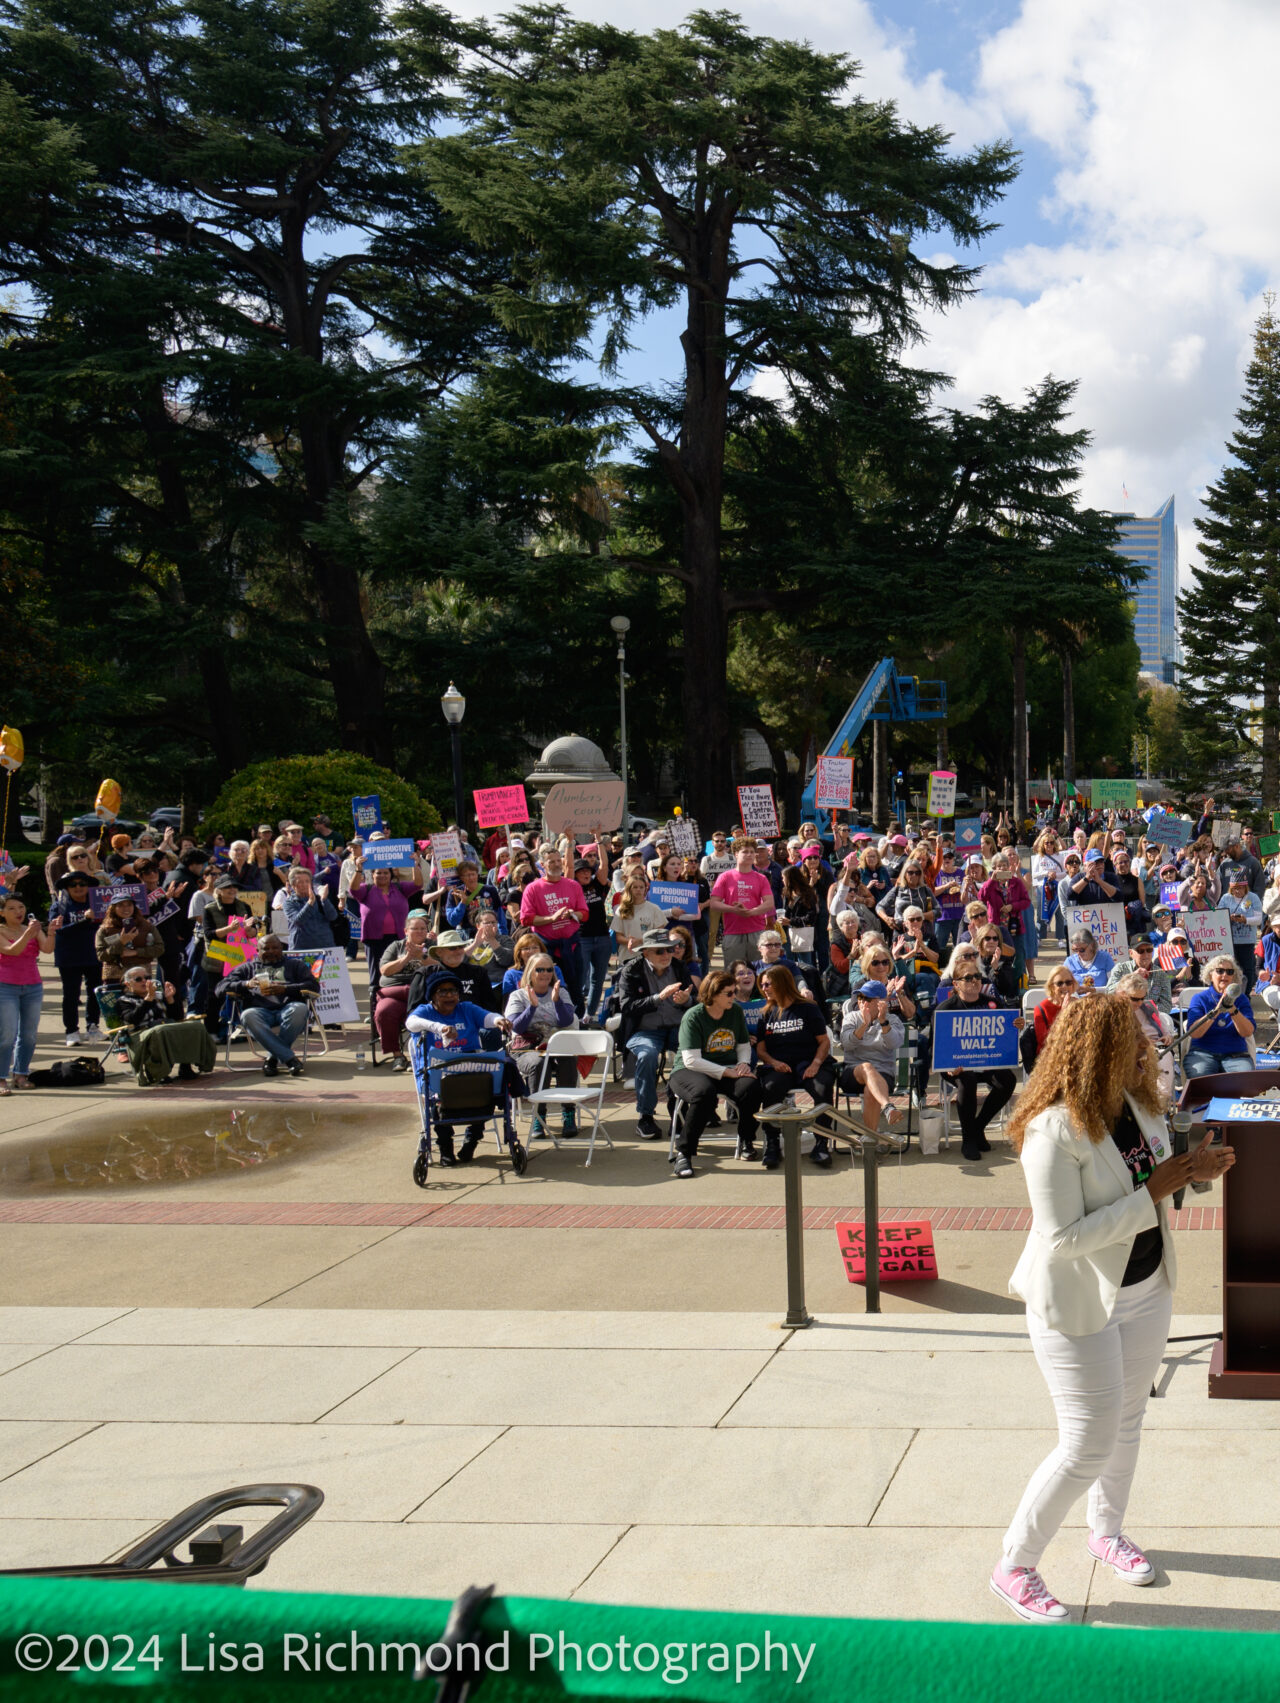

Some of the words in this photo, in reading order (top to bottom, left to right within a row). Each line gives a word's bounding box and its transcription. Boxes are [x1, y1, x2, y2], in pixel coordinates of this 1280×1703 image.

[364, 845, 413, 856] REPRODUCTIVE
[374, 852, 405, 862] FREEDOM
[95, 885, 142, 898] HARRIS
[544, 892, 557, 900] WE
[653, 886, 697, 898] REPRODUCTIVE
[545, 896, 570, 907] WON'T
[661, 895, 689, 905] FREEDOM
[1073, 909, 1109, 924] REAL
[1091, 921, 1119, 935] MEN
[1186, 926, 1216, 939] bortion
[1220, 926, 1228, 937] is
[765, 1018, 804, 1031] HARRIS
[952, 1015, 1005, 1038] HARRIS
[960, 1038, 996, 1051] WALZ
[1228, 1110, 1263, 1118] FOR
[847, 1227, 923, 1243] KEP
[846, 1259, 934, 1273] LGAL
